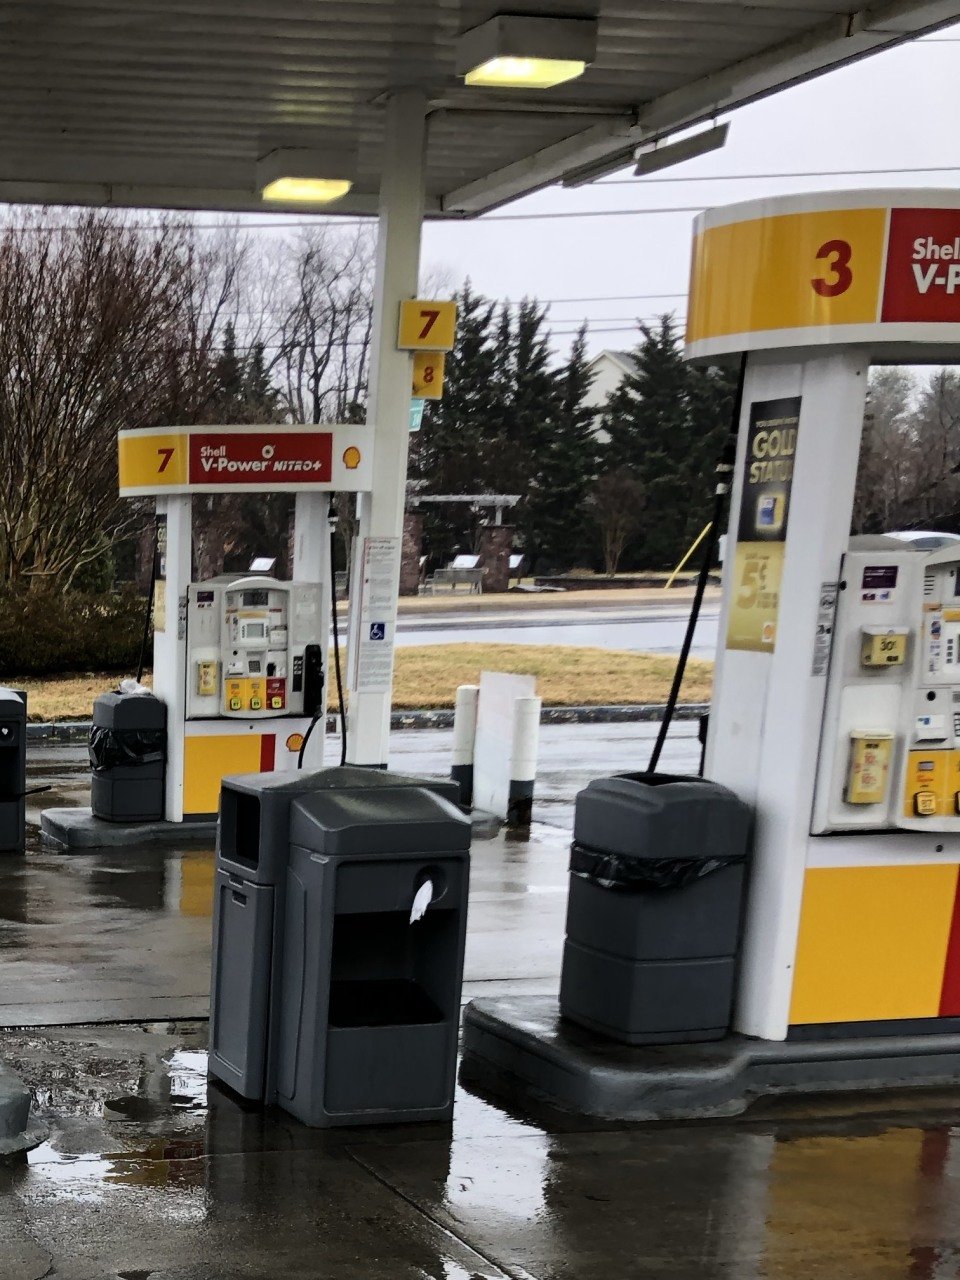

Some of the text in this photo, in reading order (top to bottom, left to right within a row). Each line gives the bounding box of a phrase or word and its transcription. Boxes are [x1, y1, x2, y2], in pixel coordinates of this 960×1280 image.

[912, 236, 960, 260] Shel
[811, 239, 853, 297] 3
[419, 311, 440, 340] 7
[423, 366, 434, 383] 8
[157, 448, 175, 472] 7
[200, 446, 226, 457] Shell
[201, 458, 268, 472] V-Power
